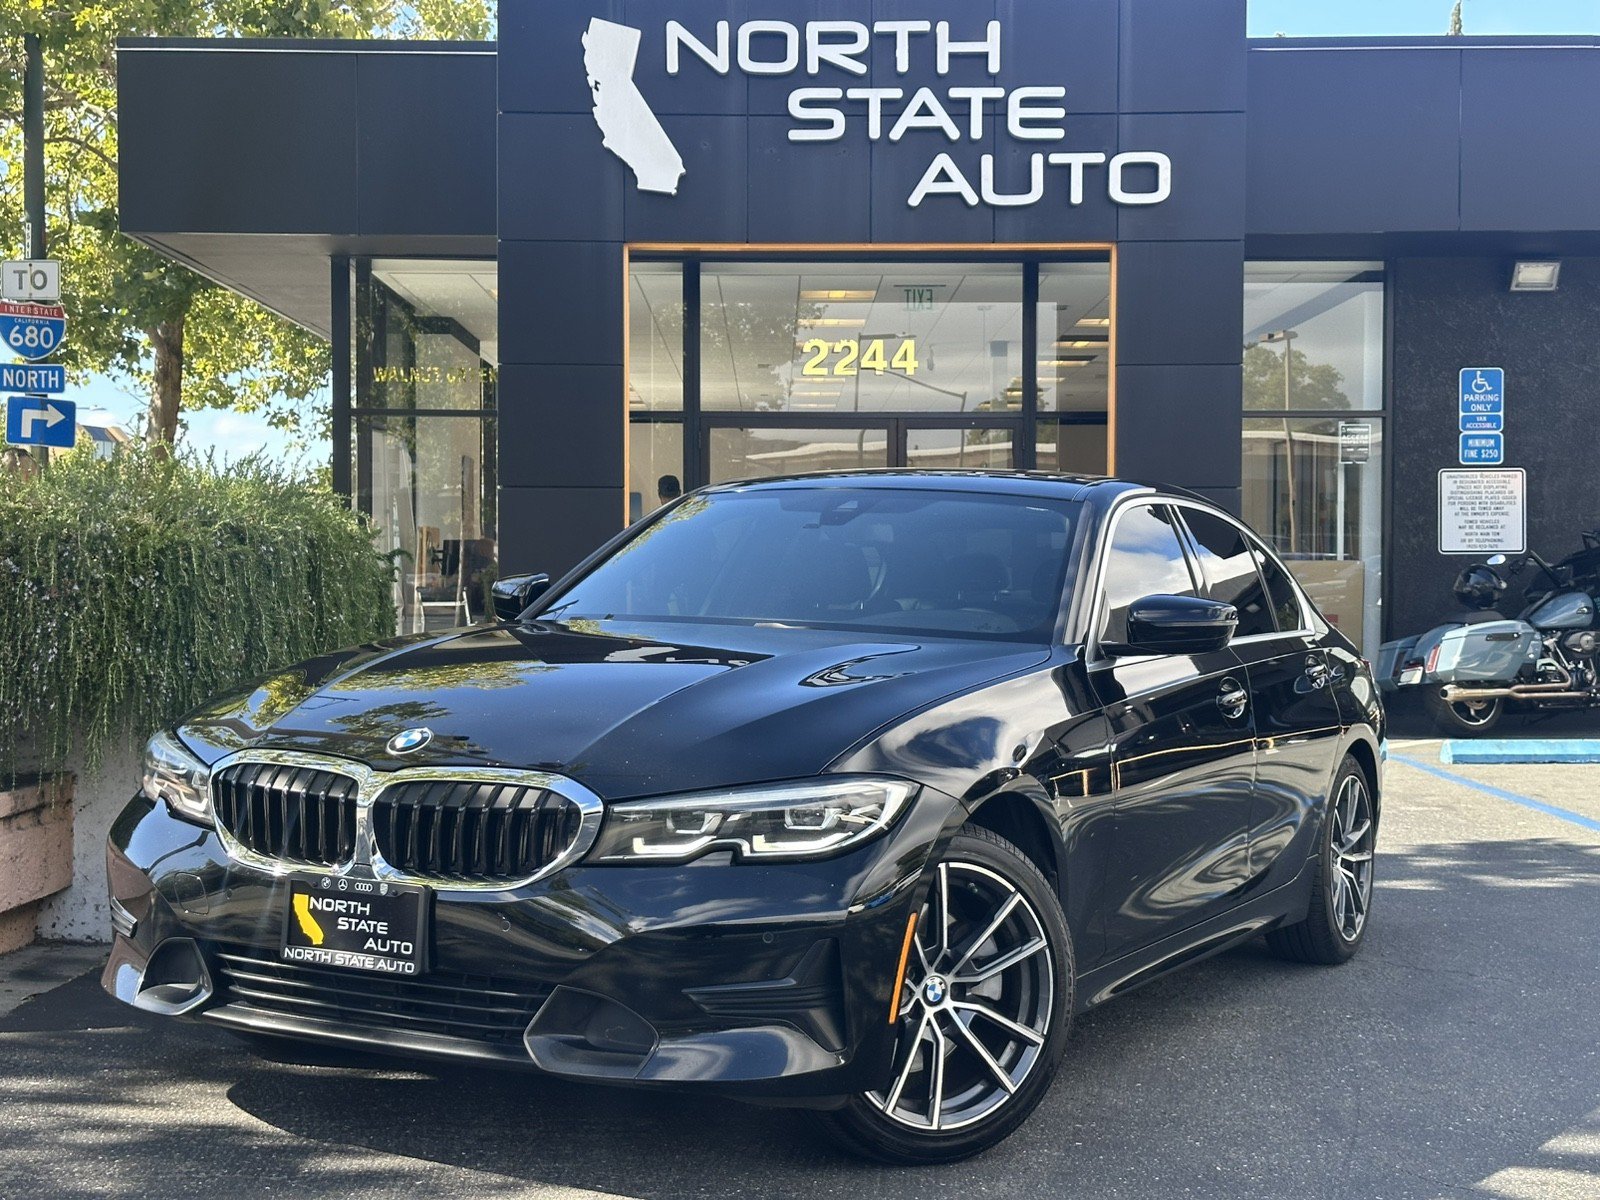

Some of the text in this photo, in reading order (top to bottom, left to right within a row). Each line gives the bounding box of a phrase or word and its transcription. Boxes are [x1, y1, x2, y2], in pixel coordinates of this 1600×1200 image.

[665, 20, 1000, 76] NORTH
[787, 86, 1066, 141] STATE
[907, 151, 1172, 207] AUTO
[13, 269, 48, 290] TO
[4, 305, 59, 317] INTERSTATE
[14, 318, 50, 326] CALIFORNIA
[9, 325, 54, 349] 680
[802, 338, 919, 376] 2244
[3, 368, 59, 389] NORTH
[372, 366, 440, 383] WALNUT
[1464, 394, 1499, 402] PARKING
[1468, 439, 1495, 447] MINIMUM
[1464, 449, 1498, 458] FINE $250
[309, 896, 371, 915] NORTH
[337, 917, 388, 935] STATE
[363, 938, 413, 955] AUTO
[284, 947, 415, 973] NORTH STATE AUTO
